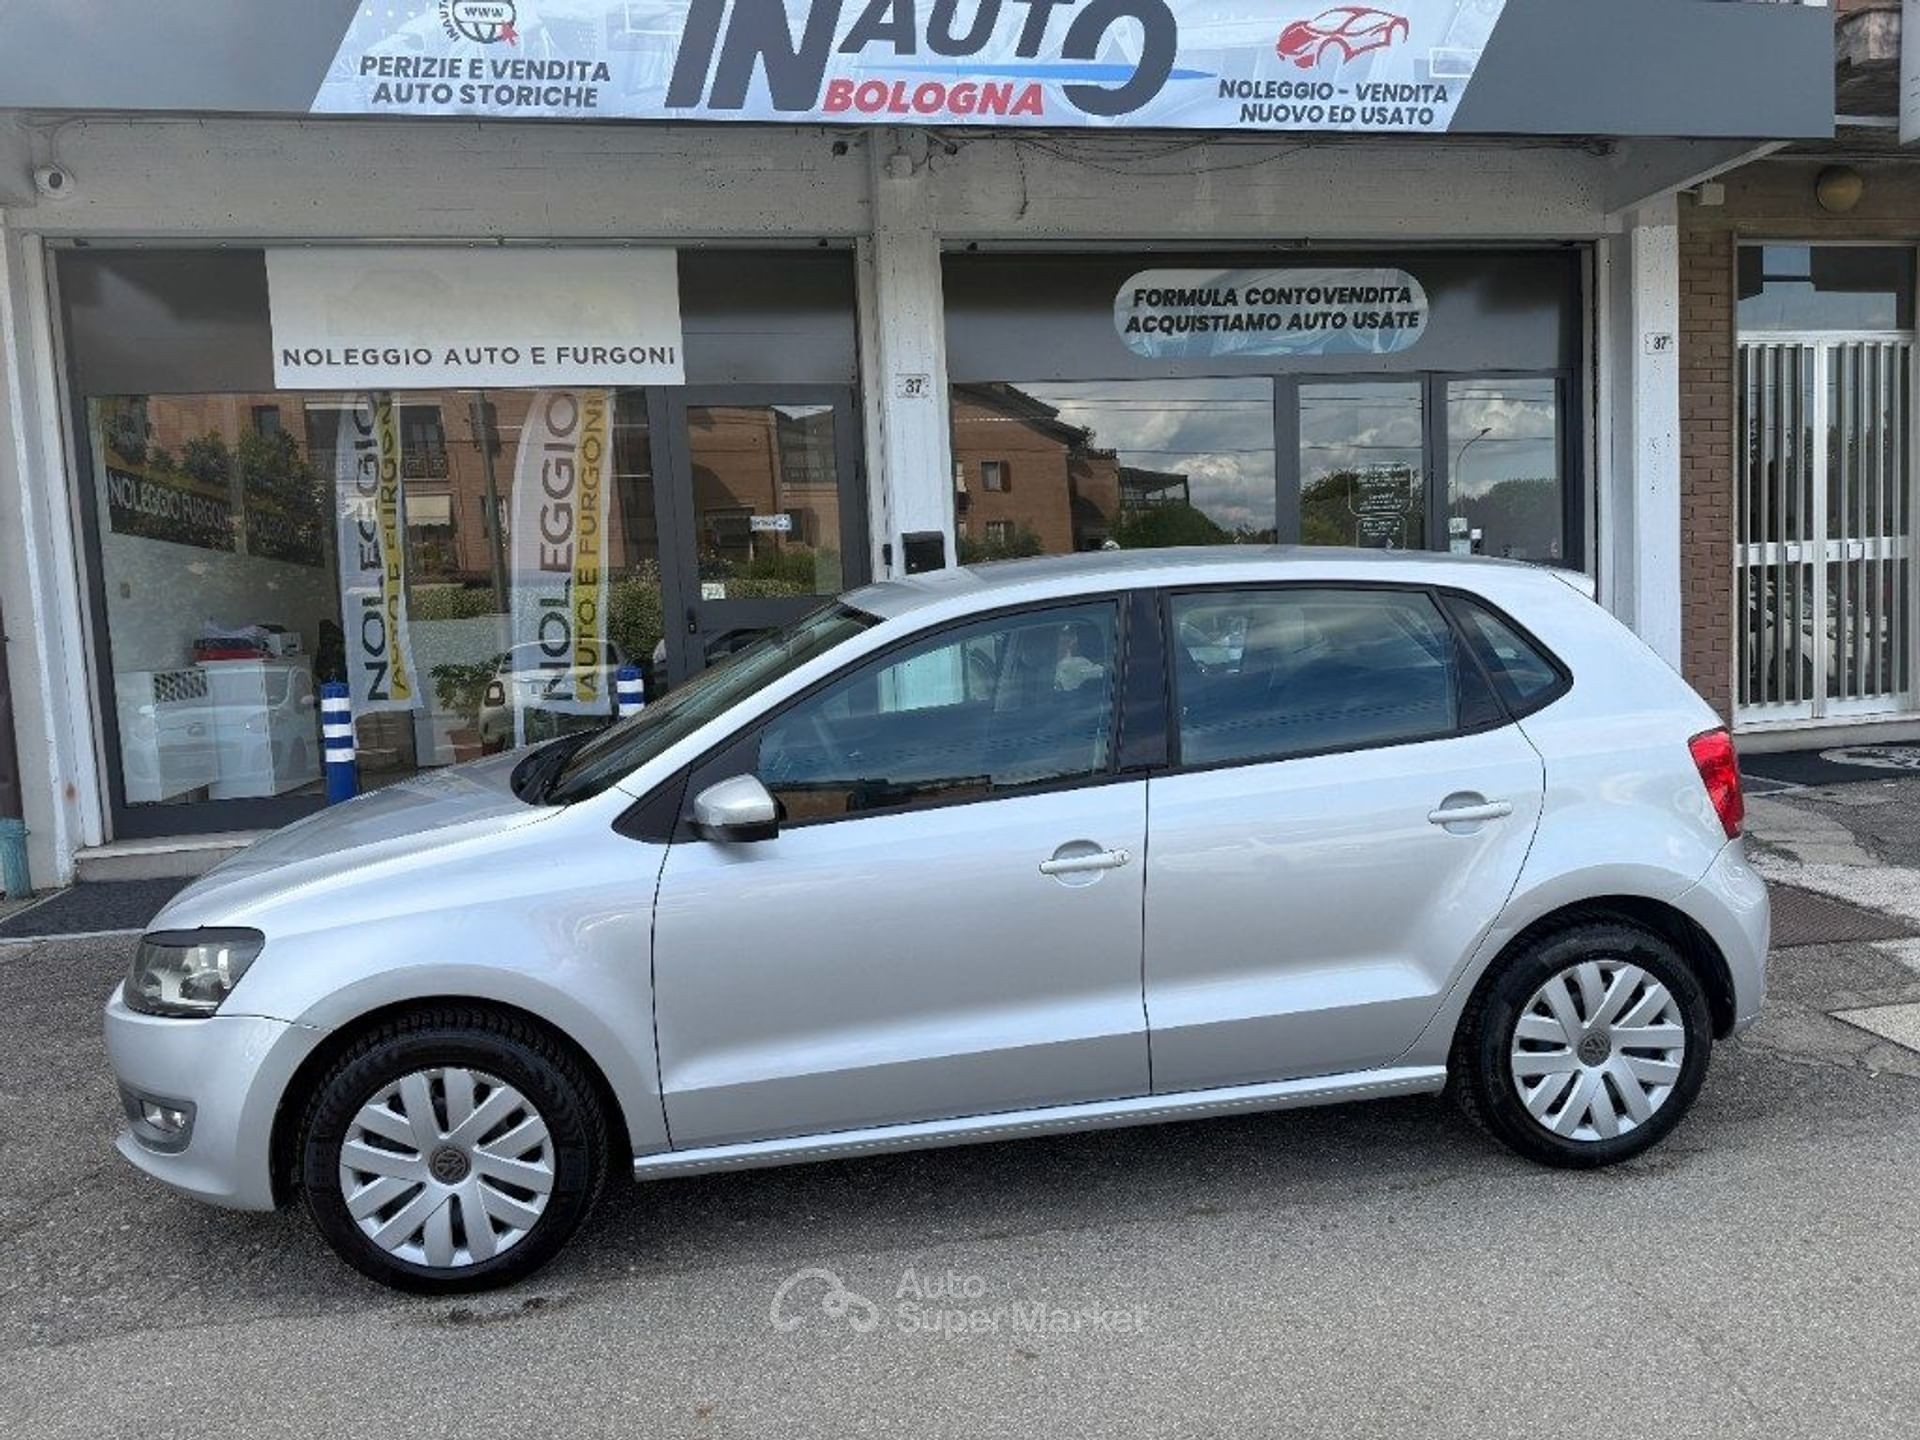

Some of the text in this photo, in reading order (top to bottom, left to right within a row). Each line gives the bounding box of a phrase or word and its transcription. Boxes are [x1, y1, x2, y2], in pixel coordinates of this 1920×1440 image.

[438, 0, 460, 42] INAUT
[359, 55, 611, 82] PERIZIE E VENDITA
[371, 82, 599, 108] AUTO STORICHE
[821, 78, 1044, 116] BOLOGNA
[1218, 79, 1334, 101] NOLEGGIO
[1355, 83, 1449, 104] VENDITA
[1239, 103, 1435, 125] NUOVO ED USATO
[1133, 285, 1412, 307] FORMULA CONTOVENDITA
[1125, 310, 1420, 335] ACQUISTIAMO AUTO USATE
[281, 345, 676, 367] NOLEGGIO AUTO E FURGONI
[538, 391, 579, 701] NOLEGGIO
[577, 567, 599, 588] E
[576, 599, 599, 693] AUTO
